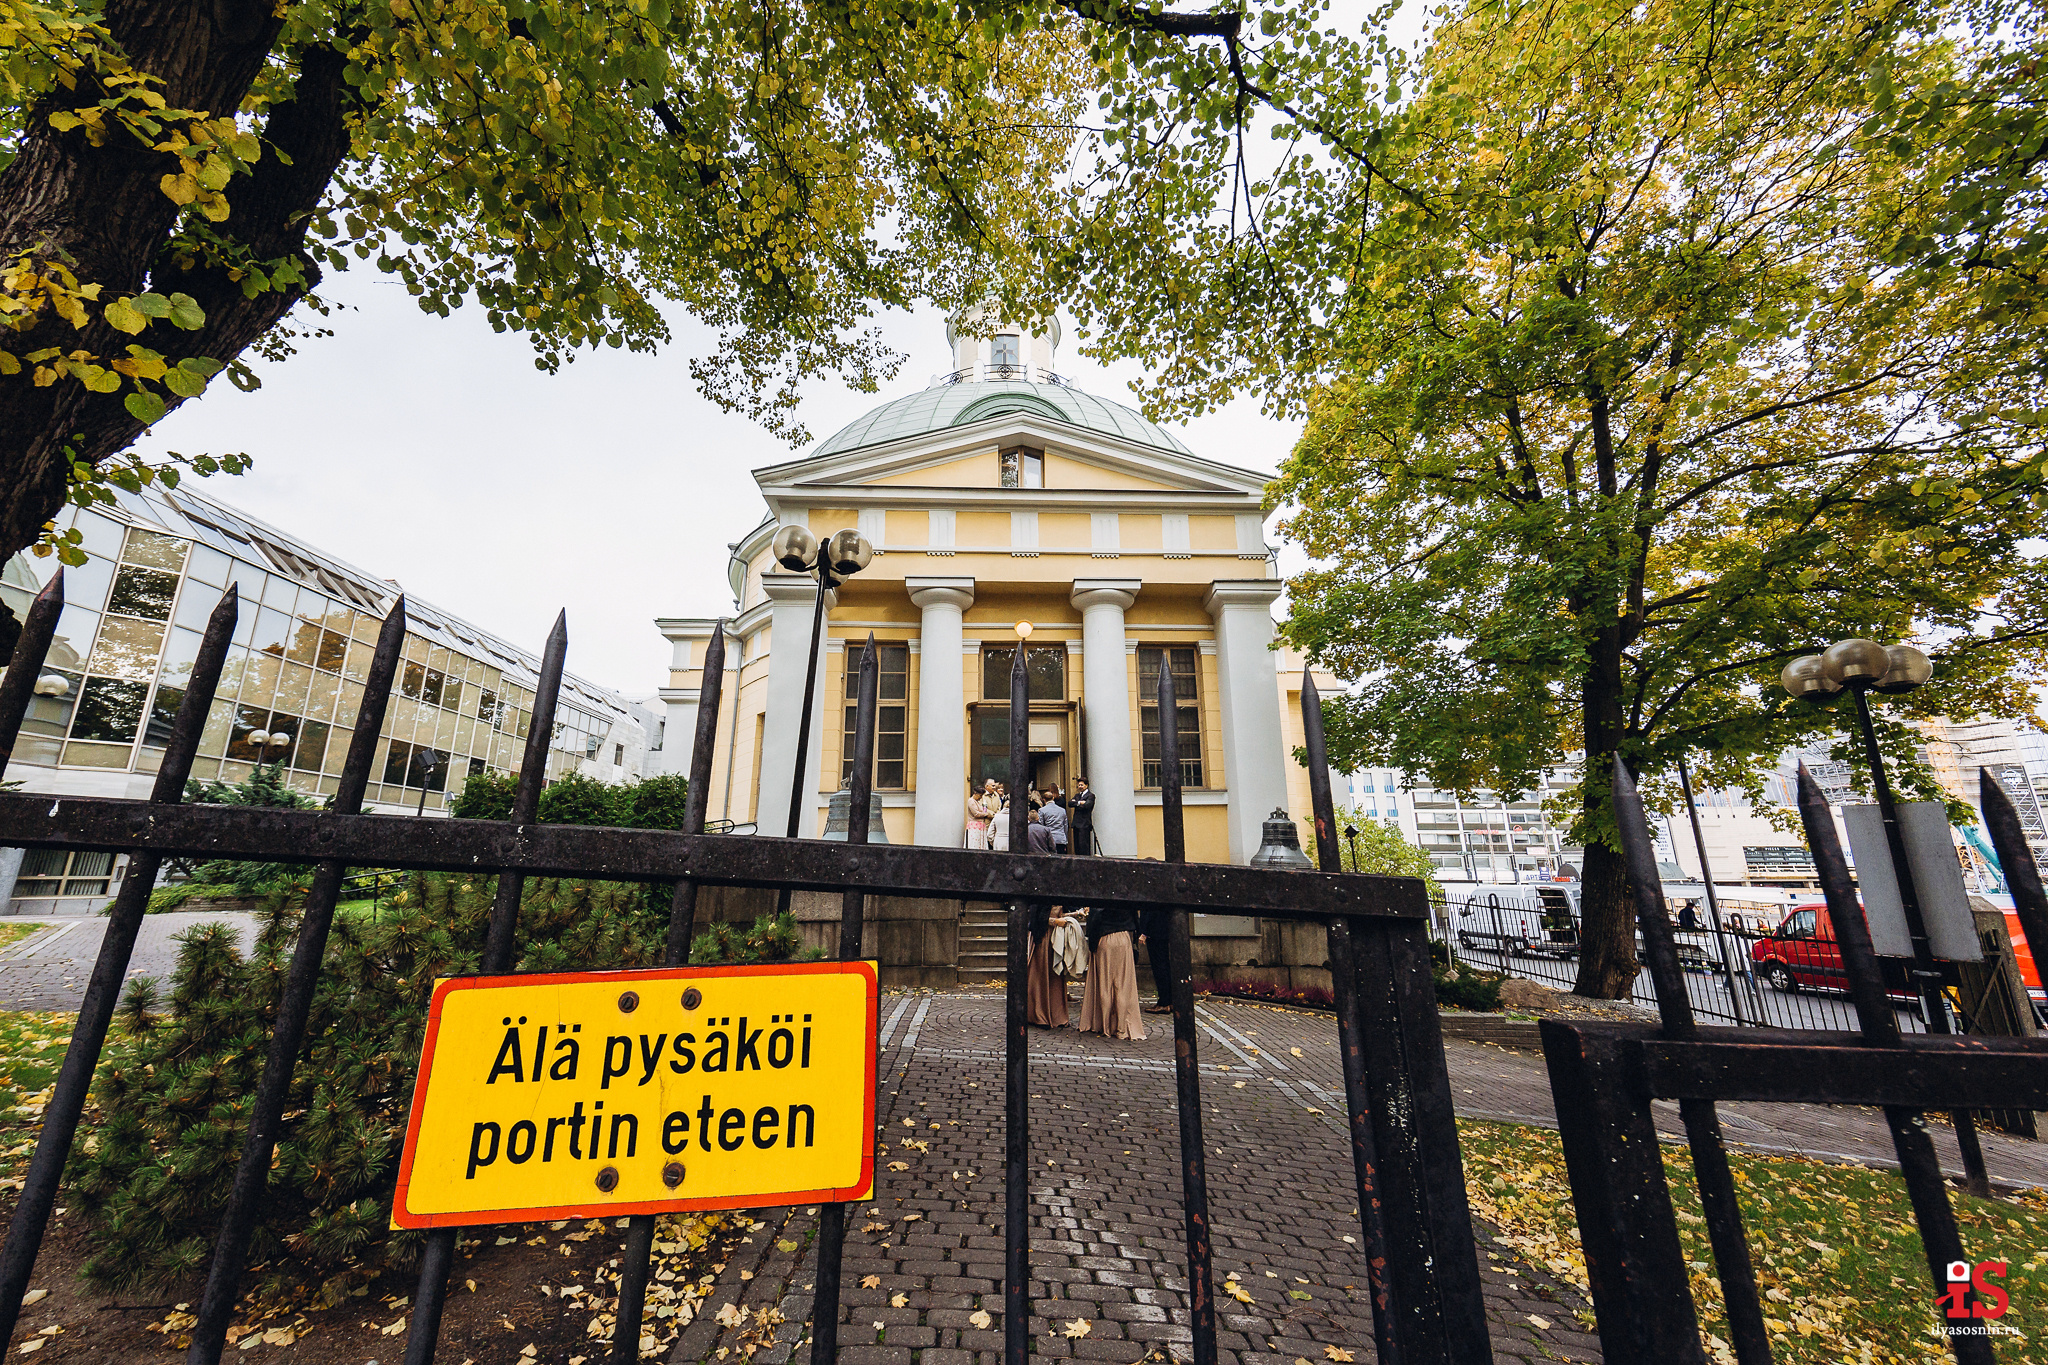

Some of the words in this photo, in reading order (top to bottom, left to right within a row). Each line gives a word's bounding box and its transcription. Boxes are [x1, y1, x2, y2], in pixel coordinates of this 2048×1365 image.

[486, 1016, 582, 1084] Älä
[601, 1013, 812, 1090] pysäköi
[465, 1100, 639, 1180] portin
[661, 1095, 815, 1155] eteen
